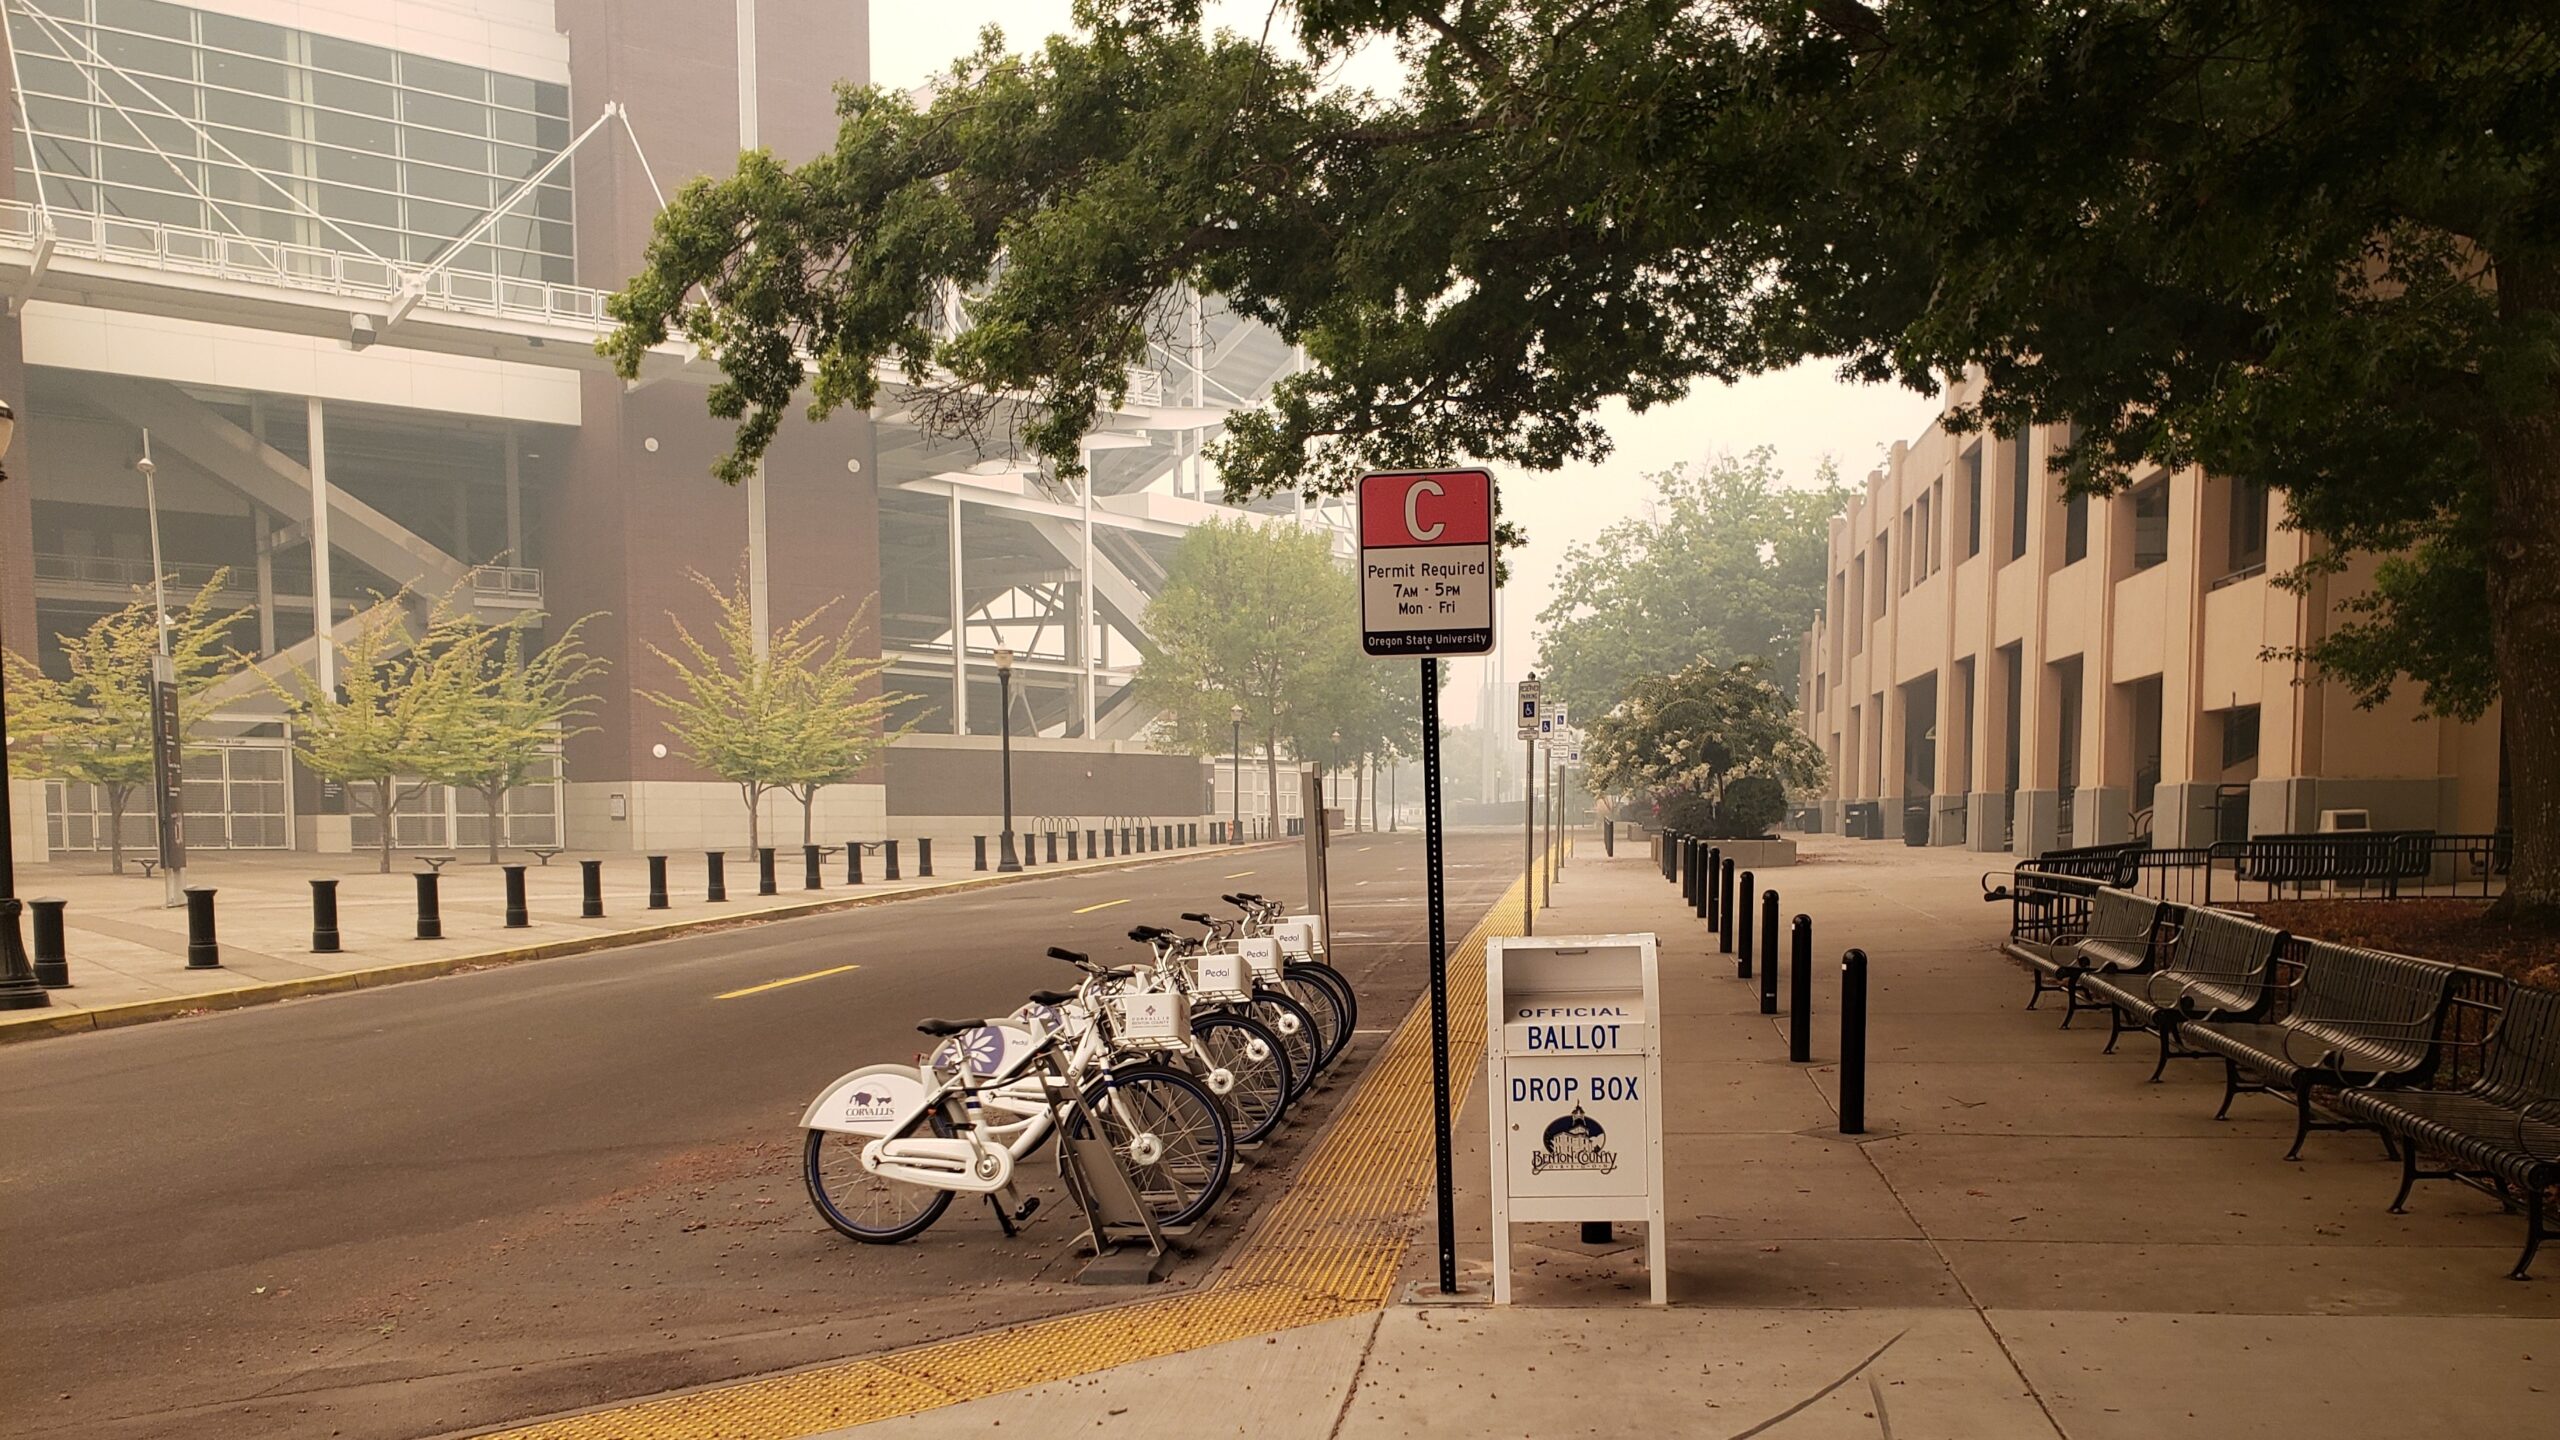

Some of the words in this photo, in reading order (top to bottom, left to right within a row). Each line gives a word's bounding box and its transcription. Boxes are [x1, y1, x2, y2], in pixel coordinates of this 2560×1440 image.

[1405, 480, 1446, 542] C
[1368, 563, 1415, 578] Permit
[1421, 561, 1484, 579] Required
[1393, 584, 1418, 598] 7AM
[1435, 582, 1460, 596] 5PM
[1399, 603, 1423, 615] Mon
[1439, 601, 1455, 613] Fri
[1368, 636, 1402, 648] Oregon
[1406, 634, 1433, 646] State
[1435, 633, 1487, 645] University
[1246, 950, 1269, 958] Pedal
[1205, 968, 1230, 977] Pedal
[1518, 1007, 1629, 1018] OFFICIAL
[1528, 1025, 1620, 1050] BALLOT
[1512, 1077, 1578, 1102] DROP
[1591, 1076, 1639, 1101] BOX
[845, 1107, 895, 1116] CORVALLIS
